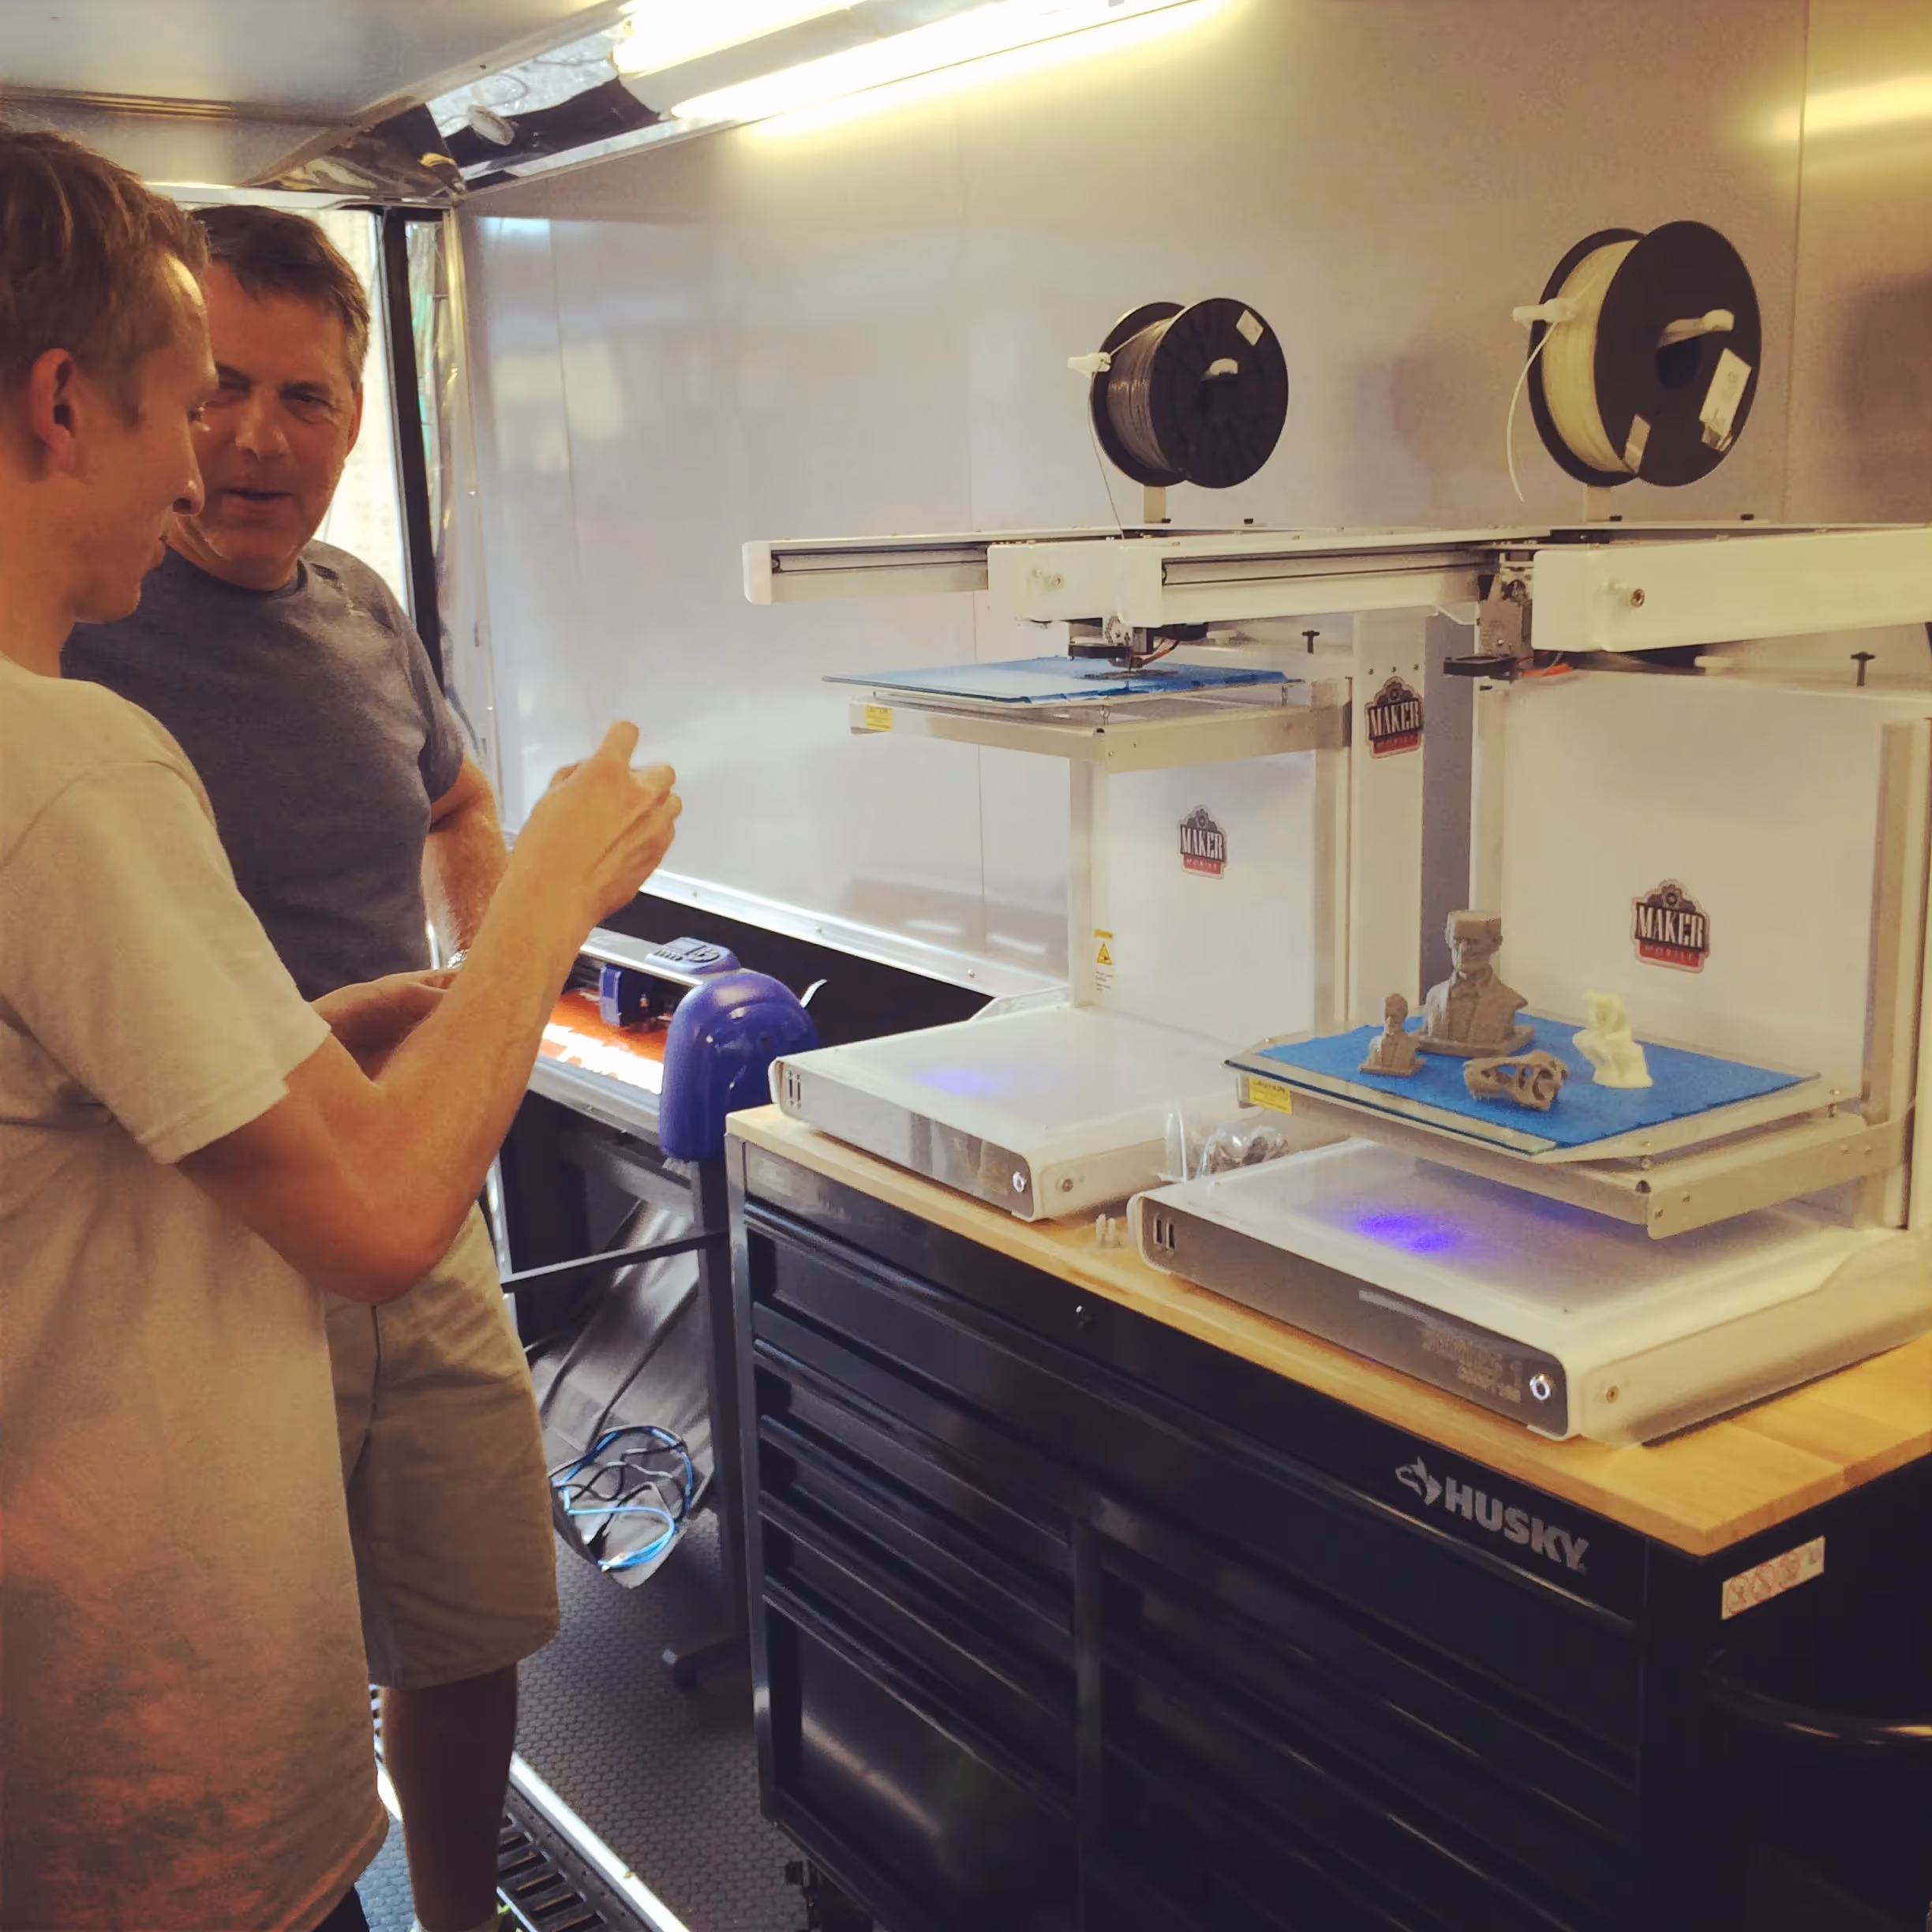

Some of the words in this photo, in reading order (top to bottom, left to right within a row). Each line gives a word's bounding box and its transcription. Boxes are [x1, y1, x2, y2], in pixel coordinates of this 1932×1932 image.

[1370, 700, 1420, 736] MAKER
[1181, 826, 1223, 859] MAKER
[1638, 905, 1704, 949] MAKER
[1444, 1476, 1589, 1572] HUSKY
